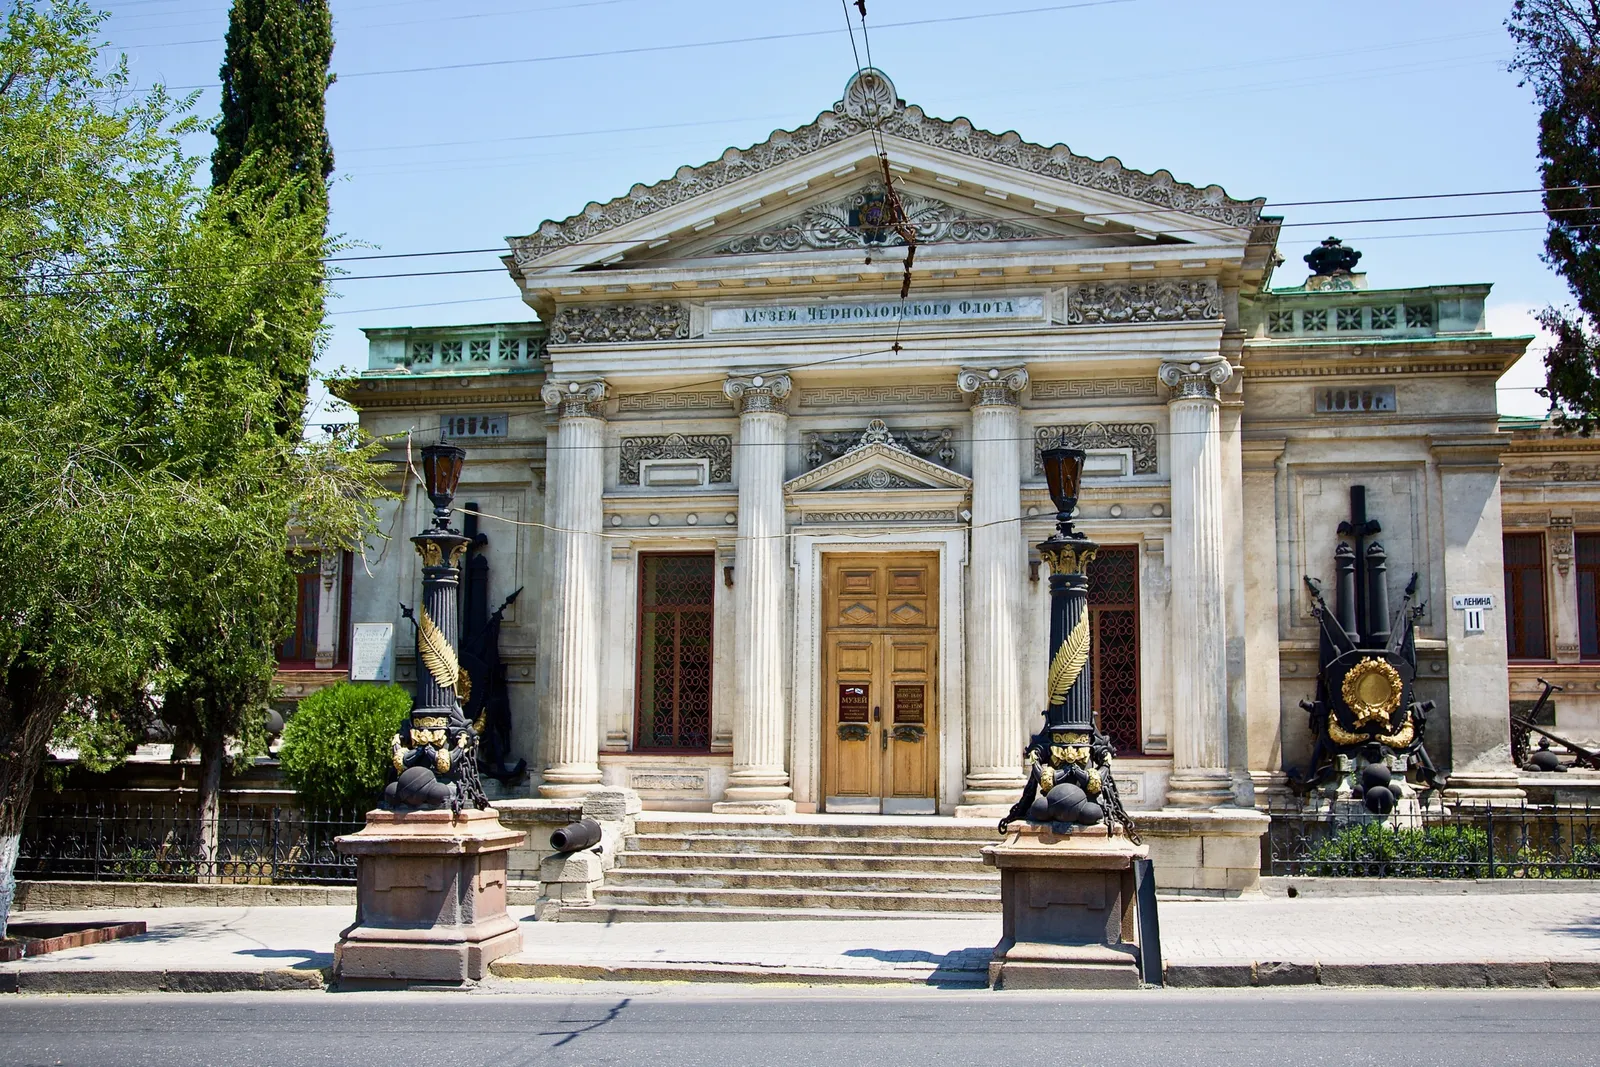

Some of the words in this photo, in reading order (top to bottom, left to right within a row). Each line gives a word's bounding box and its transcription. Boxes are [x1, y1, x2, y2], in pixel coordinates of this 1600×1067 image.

[744, 308, 797, 322] МУЗЕЙ
[959, 301, 1014, 314] ФЛОТА
[1464, 598, 1491, 606] ЛЕНИНА
[1469, 611, 1480, 629] 11
[842, 696, 868, 704] МУЗЕЙ
